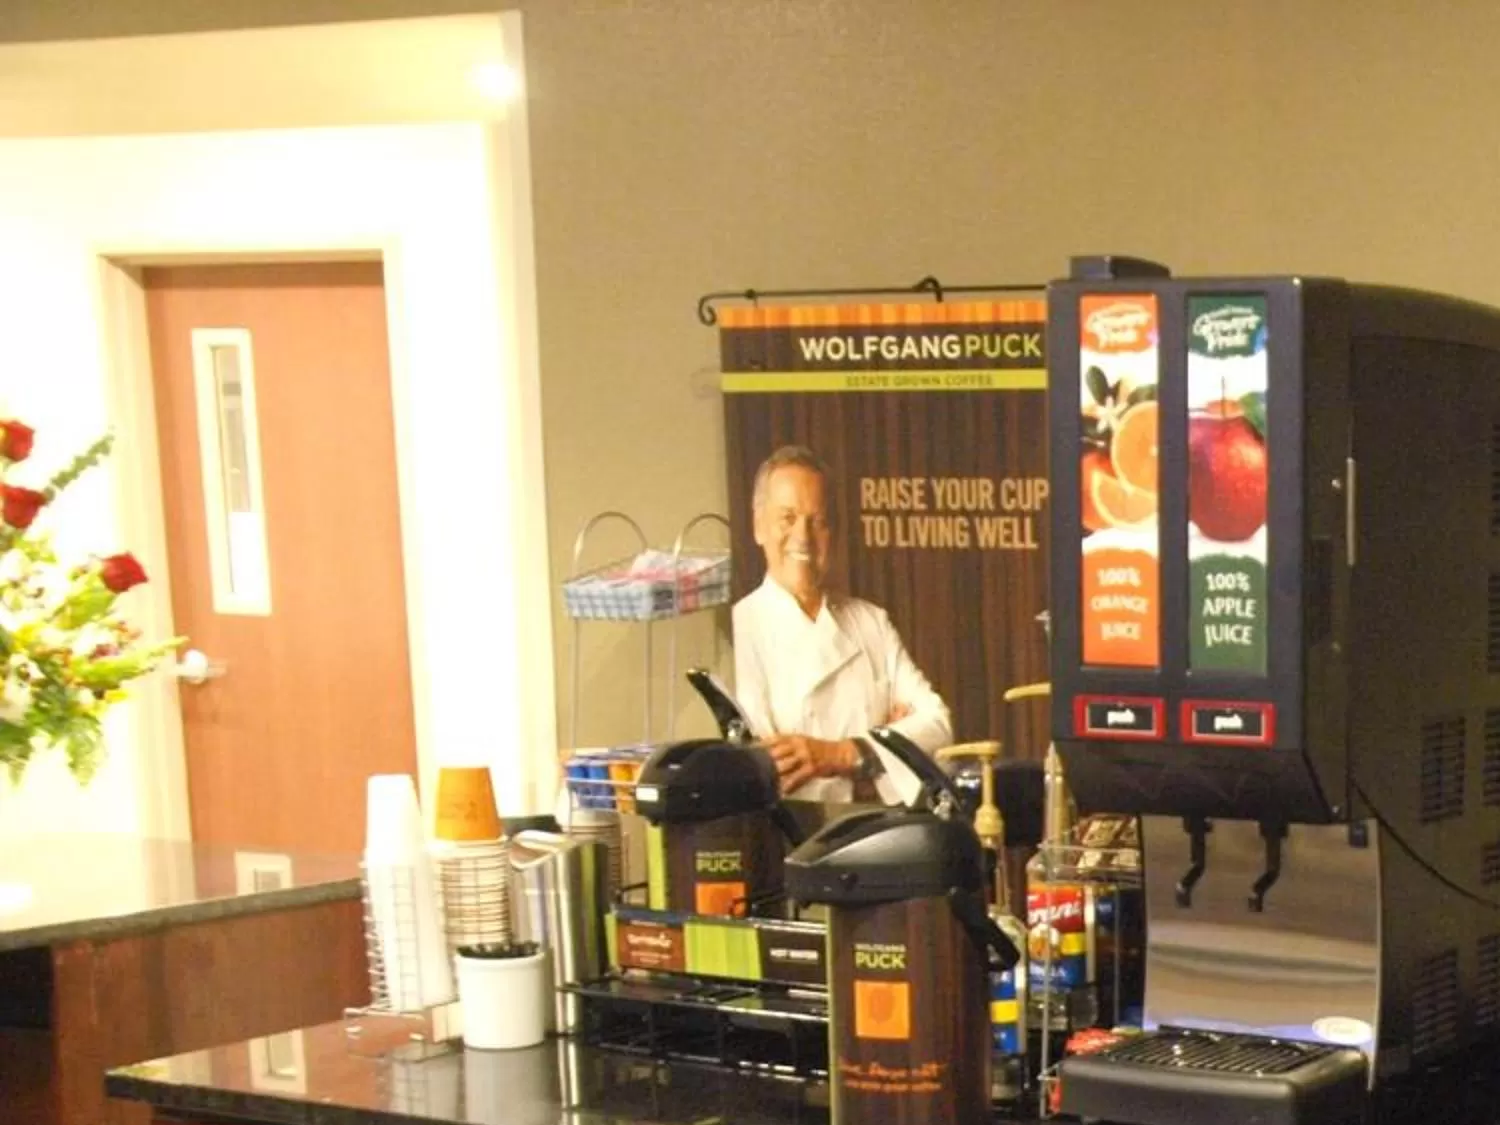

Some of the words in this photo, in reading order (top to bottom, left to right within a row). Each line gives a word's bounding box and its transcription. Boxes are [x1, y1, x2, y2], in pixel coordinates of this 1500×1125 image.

[860, 478, 926, 511] RAISE
[931, 478, 994, 511] YOUR
[1000, 478, 1050, 511] CUP
[860, 516, 889, 548] TO
[895, 516, 970, 549] LIVING
[975, 516, 1038, 550] WELL
[1205, 571, 1252, 592] 100%
[1202, 597, 1257, 618] APPLE
[1204, 624, 1253, 648] JUICE
[695, 858, 742, 873] PUCK
[854, 951, 907, 970] PUCK
